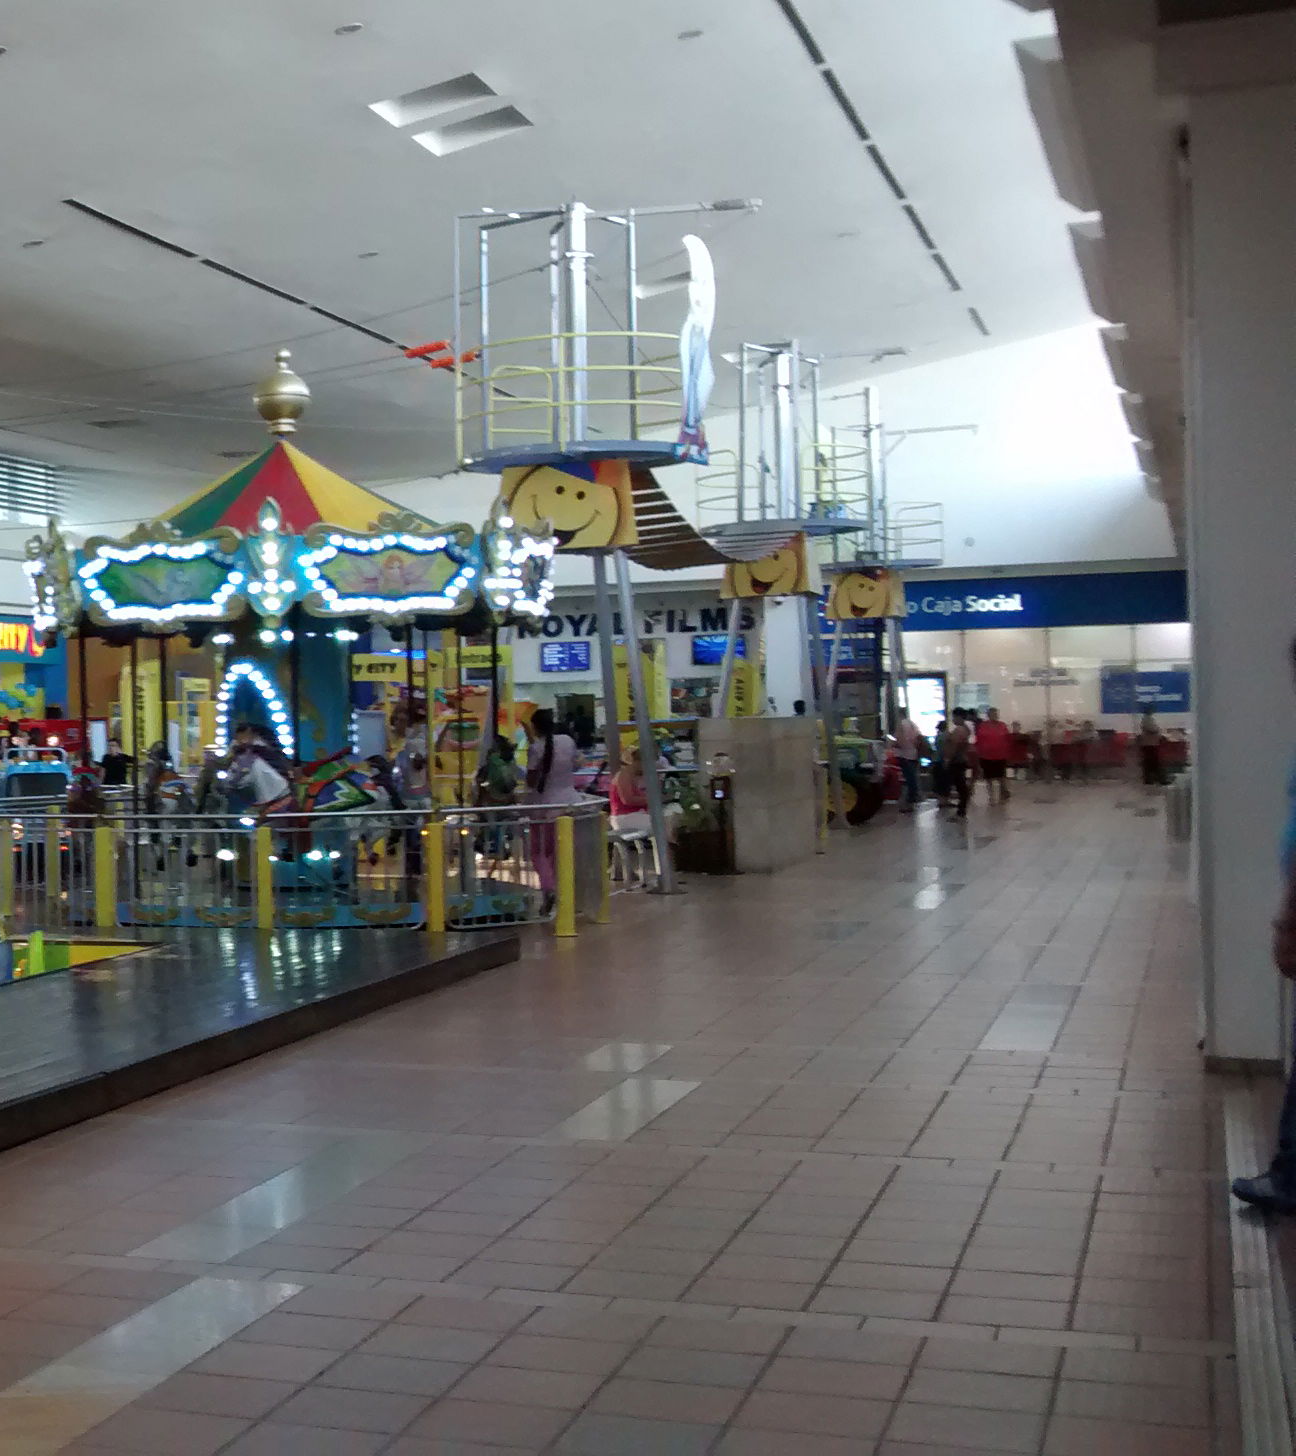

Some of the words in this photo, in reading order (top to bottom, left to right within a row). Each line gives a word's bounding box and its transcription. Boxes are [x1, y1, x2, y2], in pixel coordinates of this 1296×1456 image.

[921, 596, 963, 616] Caja
[965, 593, 1024, 613] Social
[643, 606, 755, 634] FILMS
